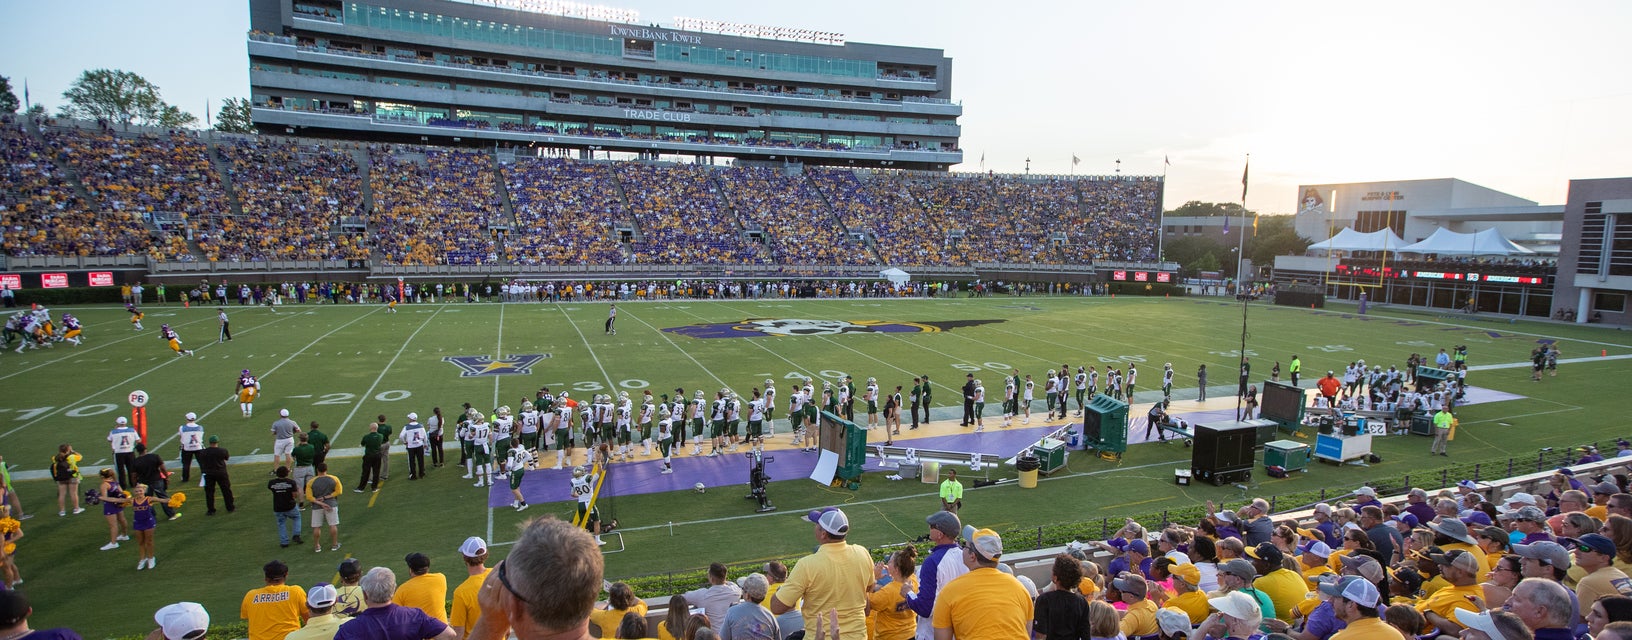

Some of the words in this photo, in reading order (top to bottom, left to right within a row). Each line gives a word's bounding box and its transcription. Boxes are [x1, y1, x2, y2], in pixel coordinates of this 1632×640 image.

[624, 109, 660, 120] TRADE
[662, 110, 691, 121] CLUB
[951, 361, 1012, 372] 50
[242, 377, 255, 386] 26
[572, 378, 650, 392] 30
[131, 394, 145, 403] P6
[311, 389, 412, 406] 20
[13, 403, 119, 421] 10
[527, 417, 536, 427] 51
[478, 428, 488, 439] 17
[1370, 424, 1384, 434] 23
[574, 484, 591, 496] 80
